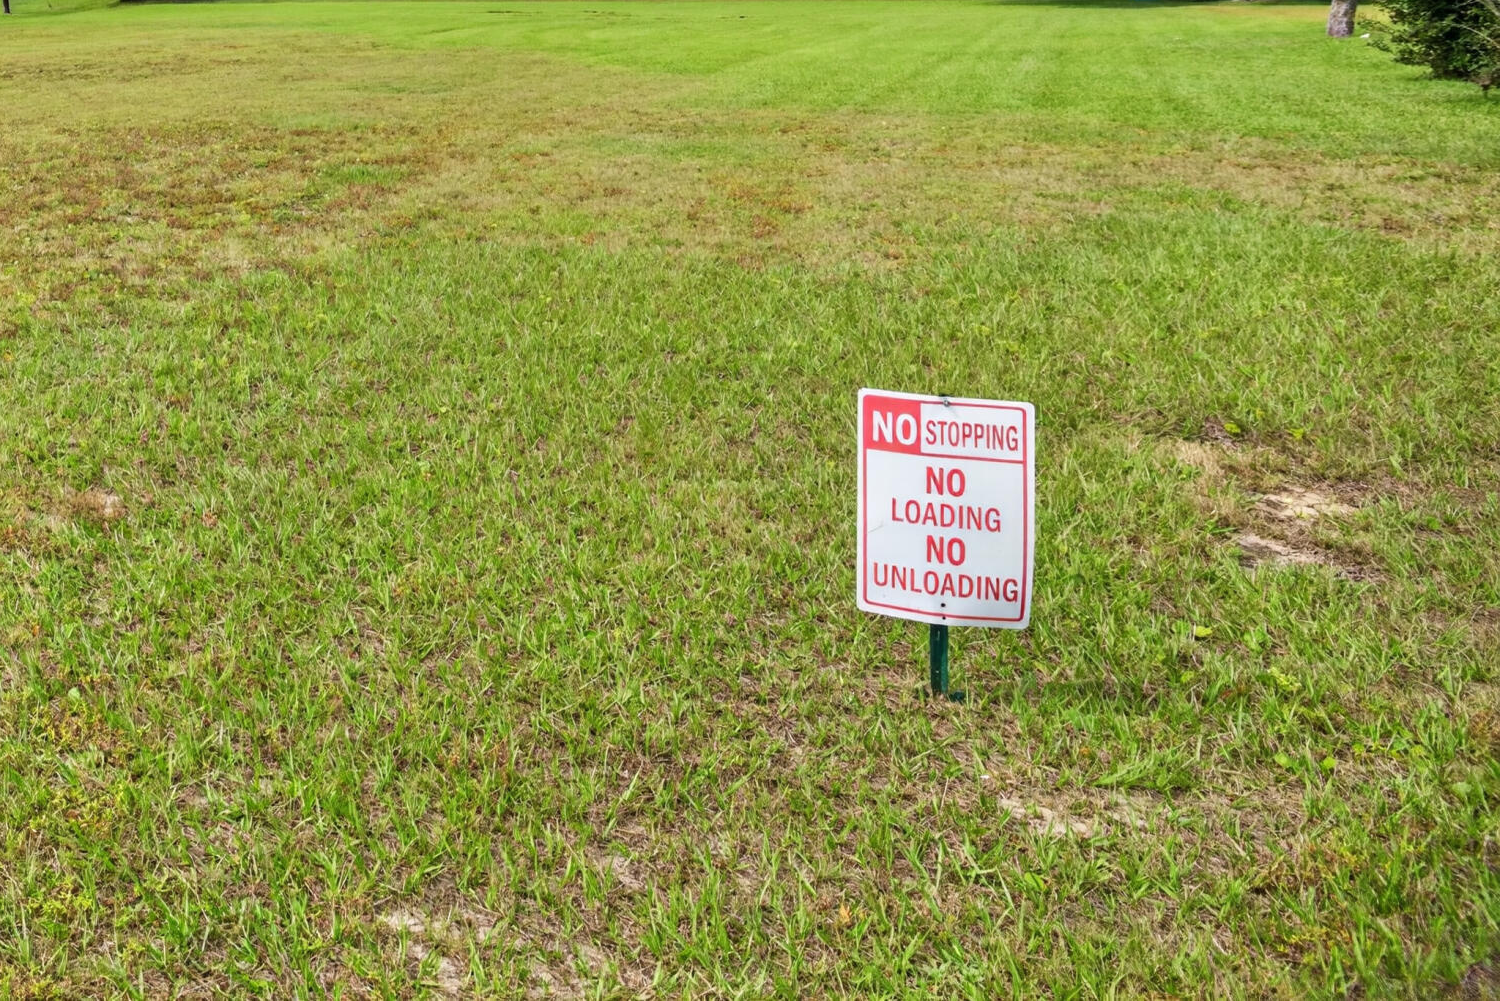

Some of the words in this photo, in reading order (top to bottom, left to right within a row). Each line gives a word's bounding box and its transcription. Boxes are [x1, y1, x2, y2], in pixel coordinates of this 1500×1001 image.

[872, 410, 918, 446] NO
[925, 420, 1018, 451] STOPPING
[925, 466, 966, 497] NO
[891, 497, 1001, 533] LOADING
[925, 534, 966, 566] NO
[874, 563, 1018, 603] UNLOADING
